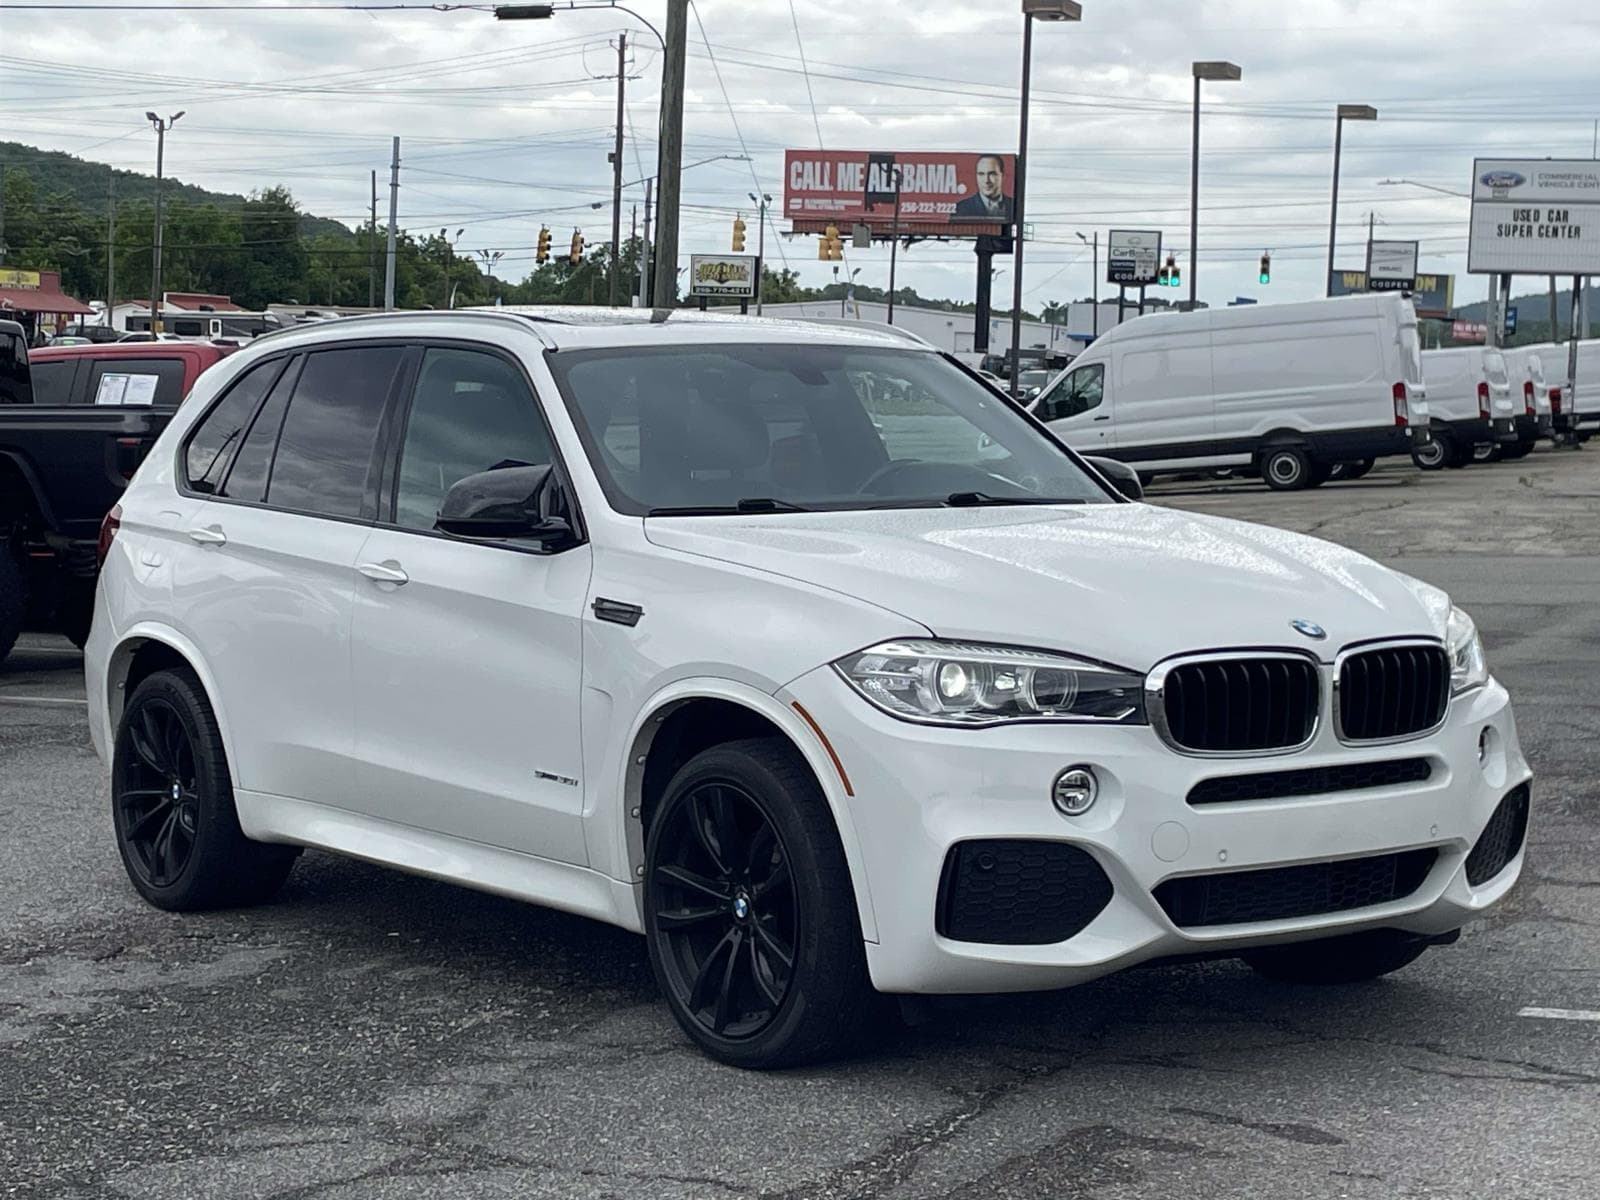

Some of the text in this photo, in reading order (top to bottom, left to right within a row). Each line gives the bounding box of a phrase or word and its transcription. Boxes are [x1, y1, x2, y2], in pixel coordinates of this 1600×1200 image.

[791, 161, 833, 190] CALL
[837, 162, 865, 191] ME
[1488, 175, 1517, 186] Ford
[1513, 208, 1569, 223] USED CAR
[1497, 223, 1581, 239] SUPER CENTER
[1371, 281, 1408, 289] COOPER
